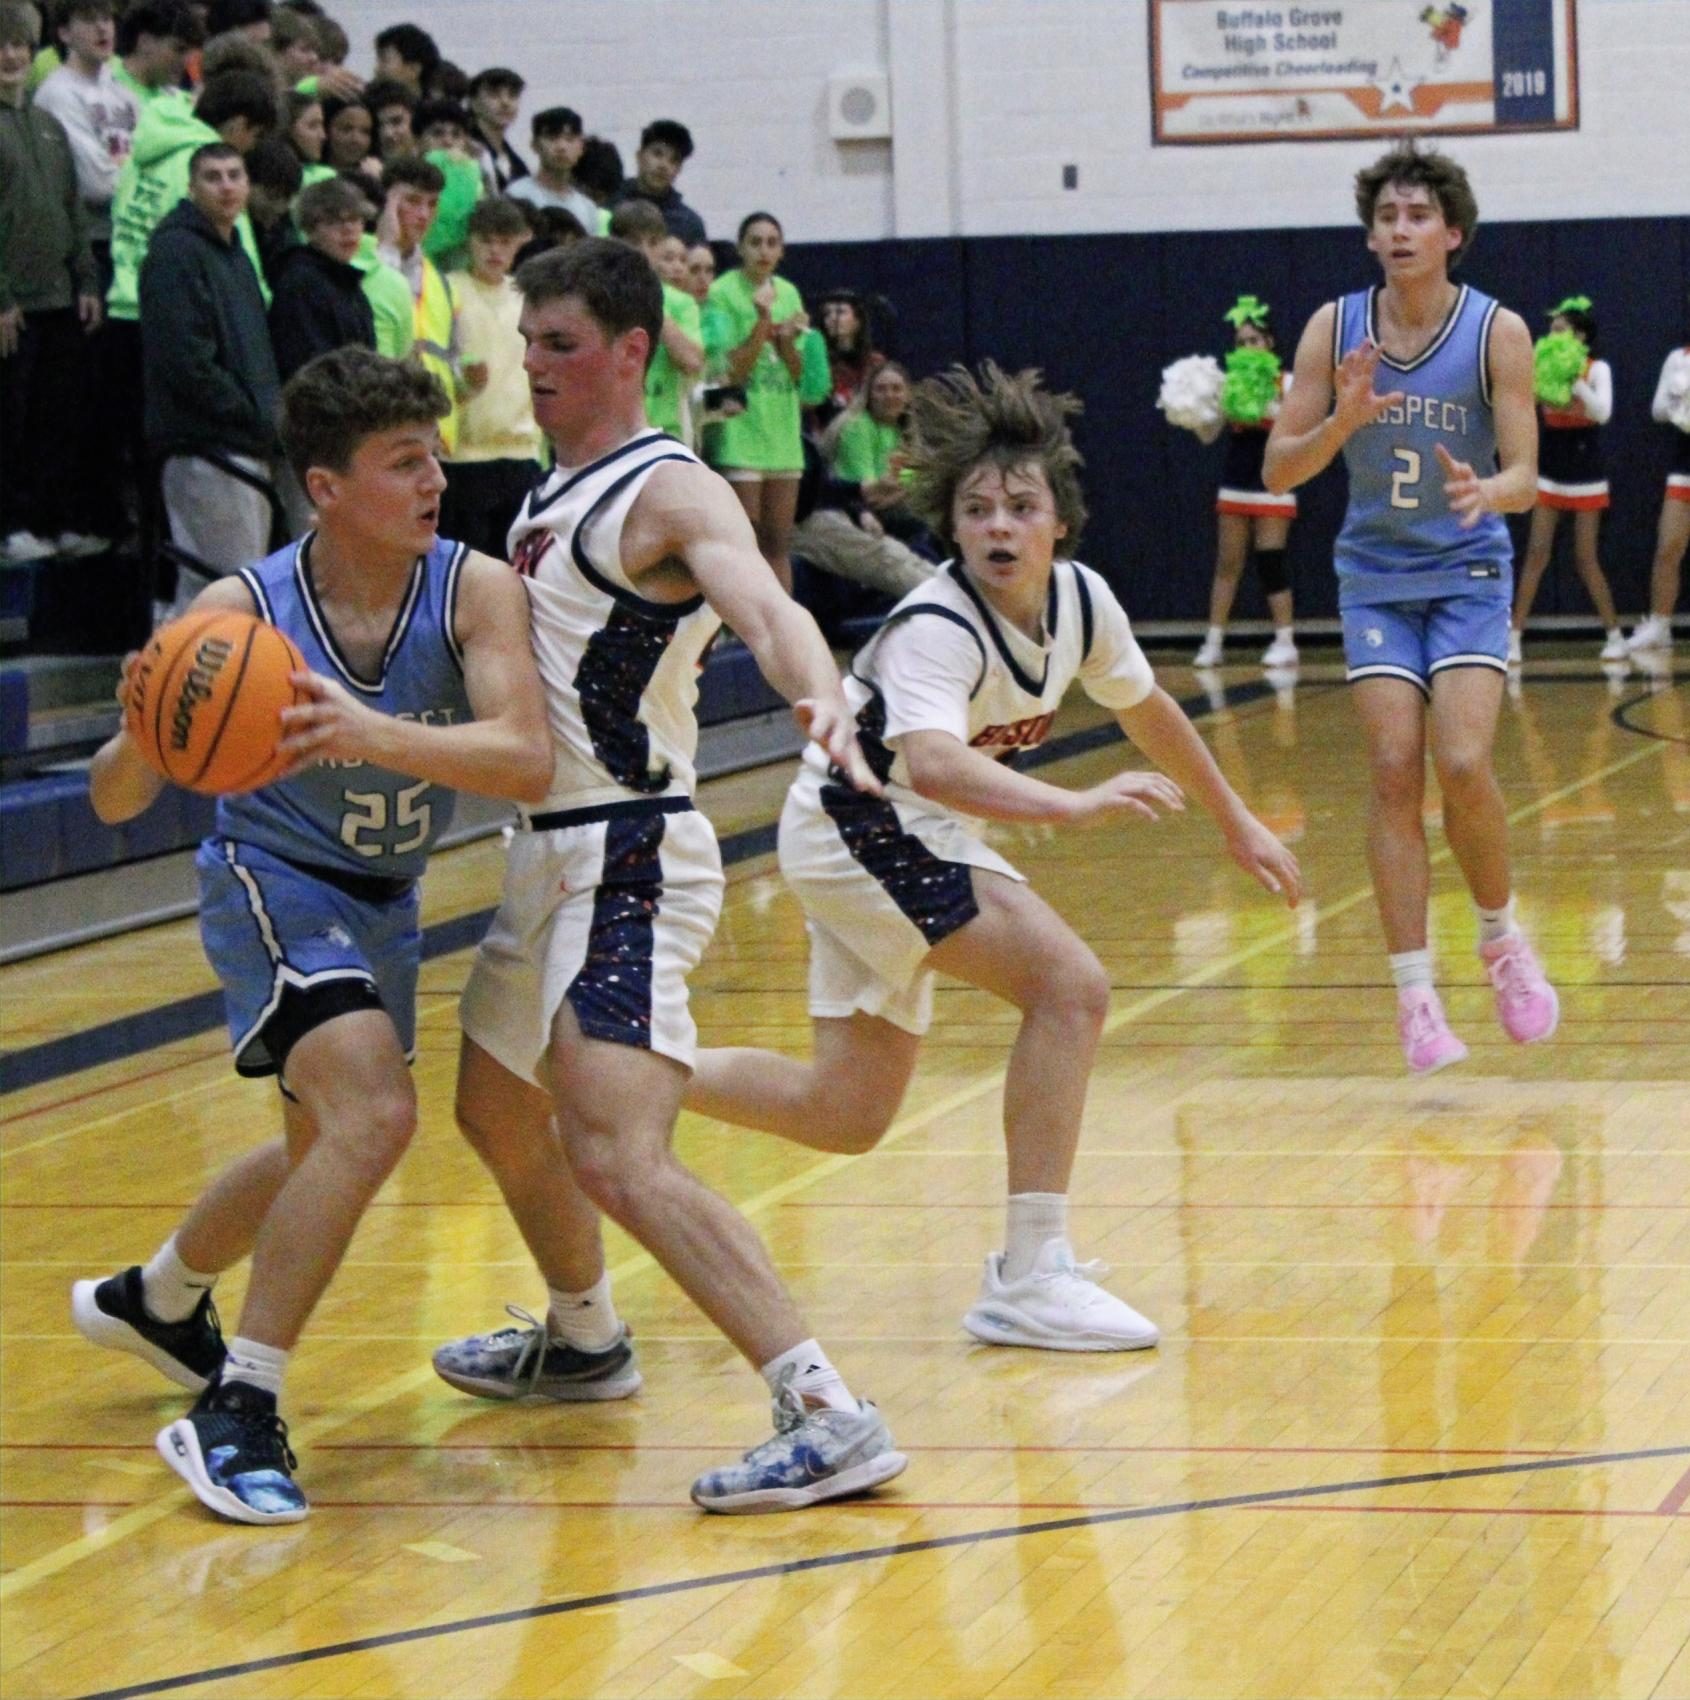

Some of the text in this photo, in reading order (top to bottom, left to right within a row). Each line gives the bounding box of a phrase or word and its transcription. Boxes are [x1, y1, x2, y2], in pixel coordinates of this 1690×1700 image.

[1217, 8, 1342, 29] Buffalo Grove
[1225, 31, 1337, 56] High School
[1182, 60, 1378, 81] Competitive Cheerleading
[1369, 396, 1467, 435] OSPECT
[1391, 449, 1420, 509] 2
[168, 637, 235, 752] Wilson
[341, 779, 431, 856] 25
